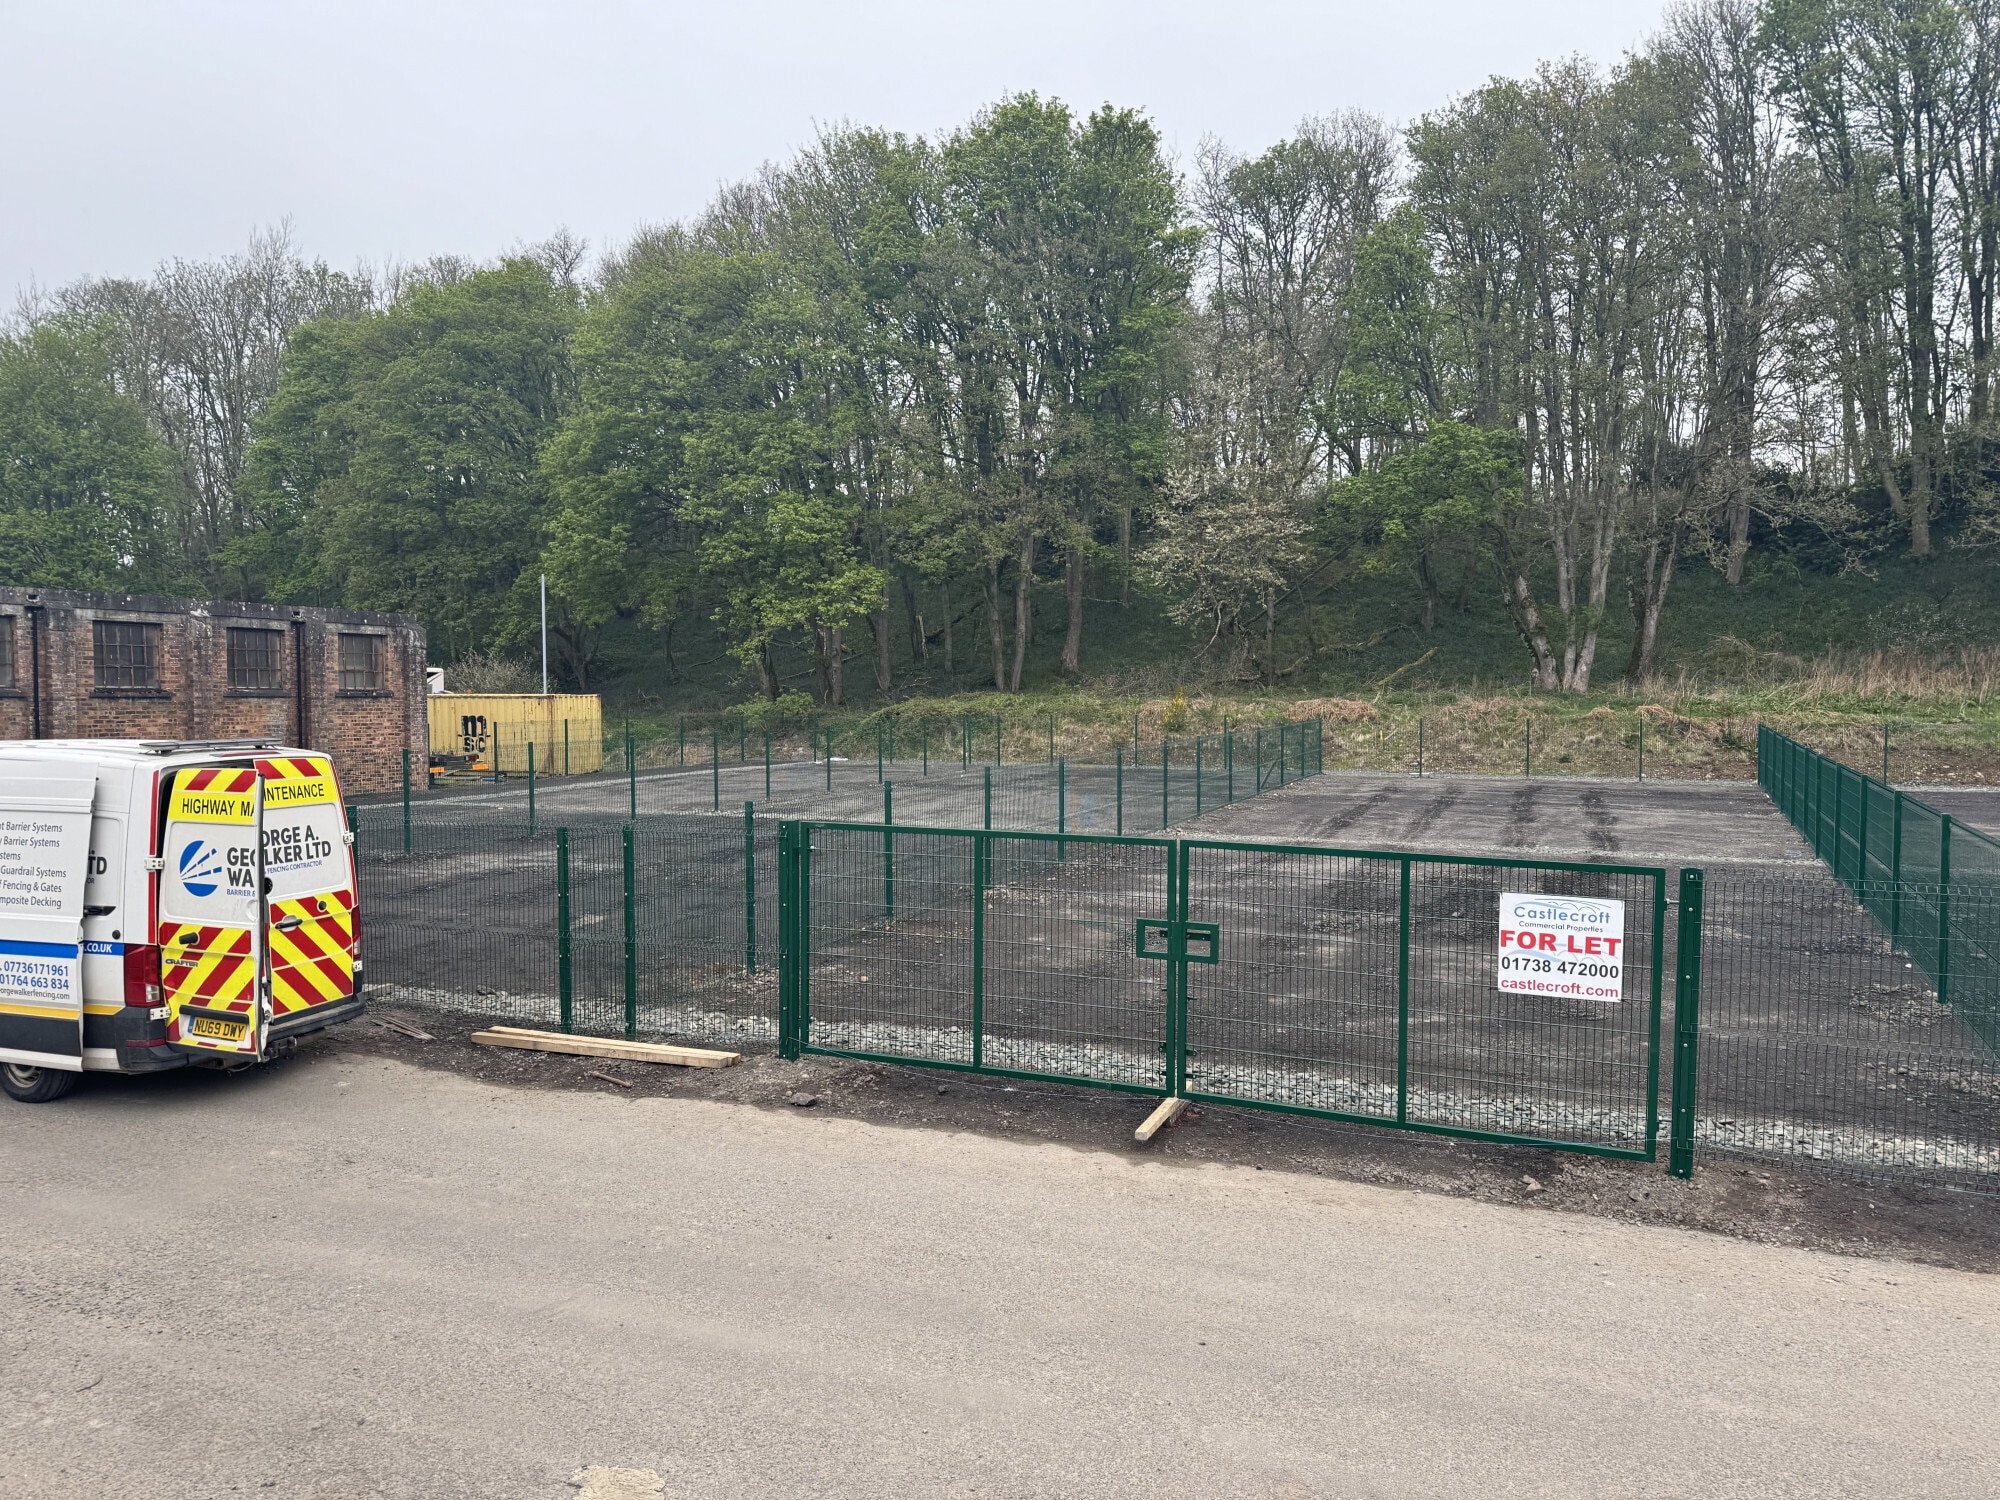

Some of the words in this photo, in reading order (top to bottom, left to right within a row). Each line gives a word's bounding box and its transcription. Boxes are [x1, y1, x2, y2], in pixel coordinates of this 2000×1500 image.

[182, 798, 235, 816] HIGHWAY
[6, 821, 31, 831] Barrier
[32, 822, 63, 834] Systems
[305, 825, 319, 841] A.
[3, 835, 28, 846] Barrier
[29, 837, 60, 848] Systems
[305, 840, 332, 860] LTD
[1, 865, 35, 877] Guardrail
[36, 867, 67, 878] Systems
[267, 863, 289, 874] FENCING
[289, 860, 323, 871] CONTRACTOR
[227, 868, 254, 888] WA
[3, 880, 31, 893] Fencing
[33, 882, 39, 892] &
[40, 882, 62, 893] Gates
[226, 888, 251, 897] BARRIER
[30, 896, 62, 909] Decking
[1514, 906, 1610, 924] Castlecroft
[1518, 920, 1565, 930] Commercial
[1566, 924, 1604, 933] Properties
[1500, 930, 1557, 952] FOR
[1567, 934, 1622, 957] LET
[4, 961, 69, 977] 07736171961
[165, 958, 198, 968] CRAFTER
[1501, 956, 1551, 973] 01738
[1557, 960, 1619, 979] 472000
[0, 974, 28, 987] 01764
[30, 976, 48, 988] 663
[51, 978, 69, 990] 834
[1501, 979, 1619, 998] castlecroft.com
[194, 1017, 222, 1034] NU69
[223, 1023, 245, 1038] DWY
